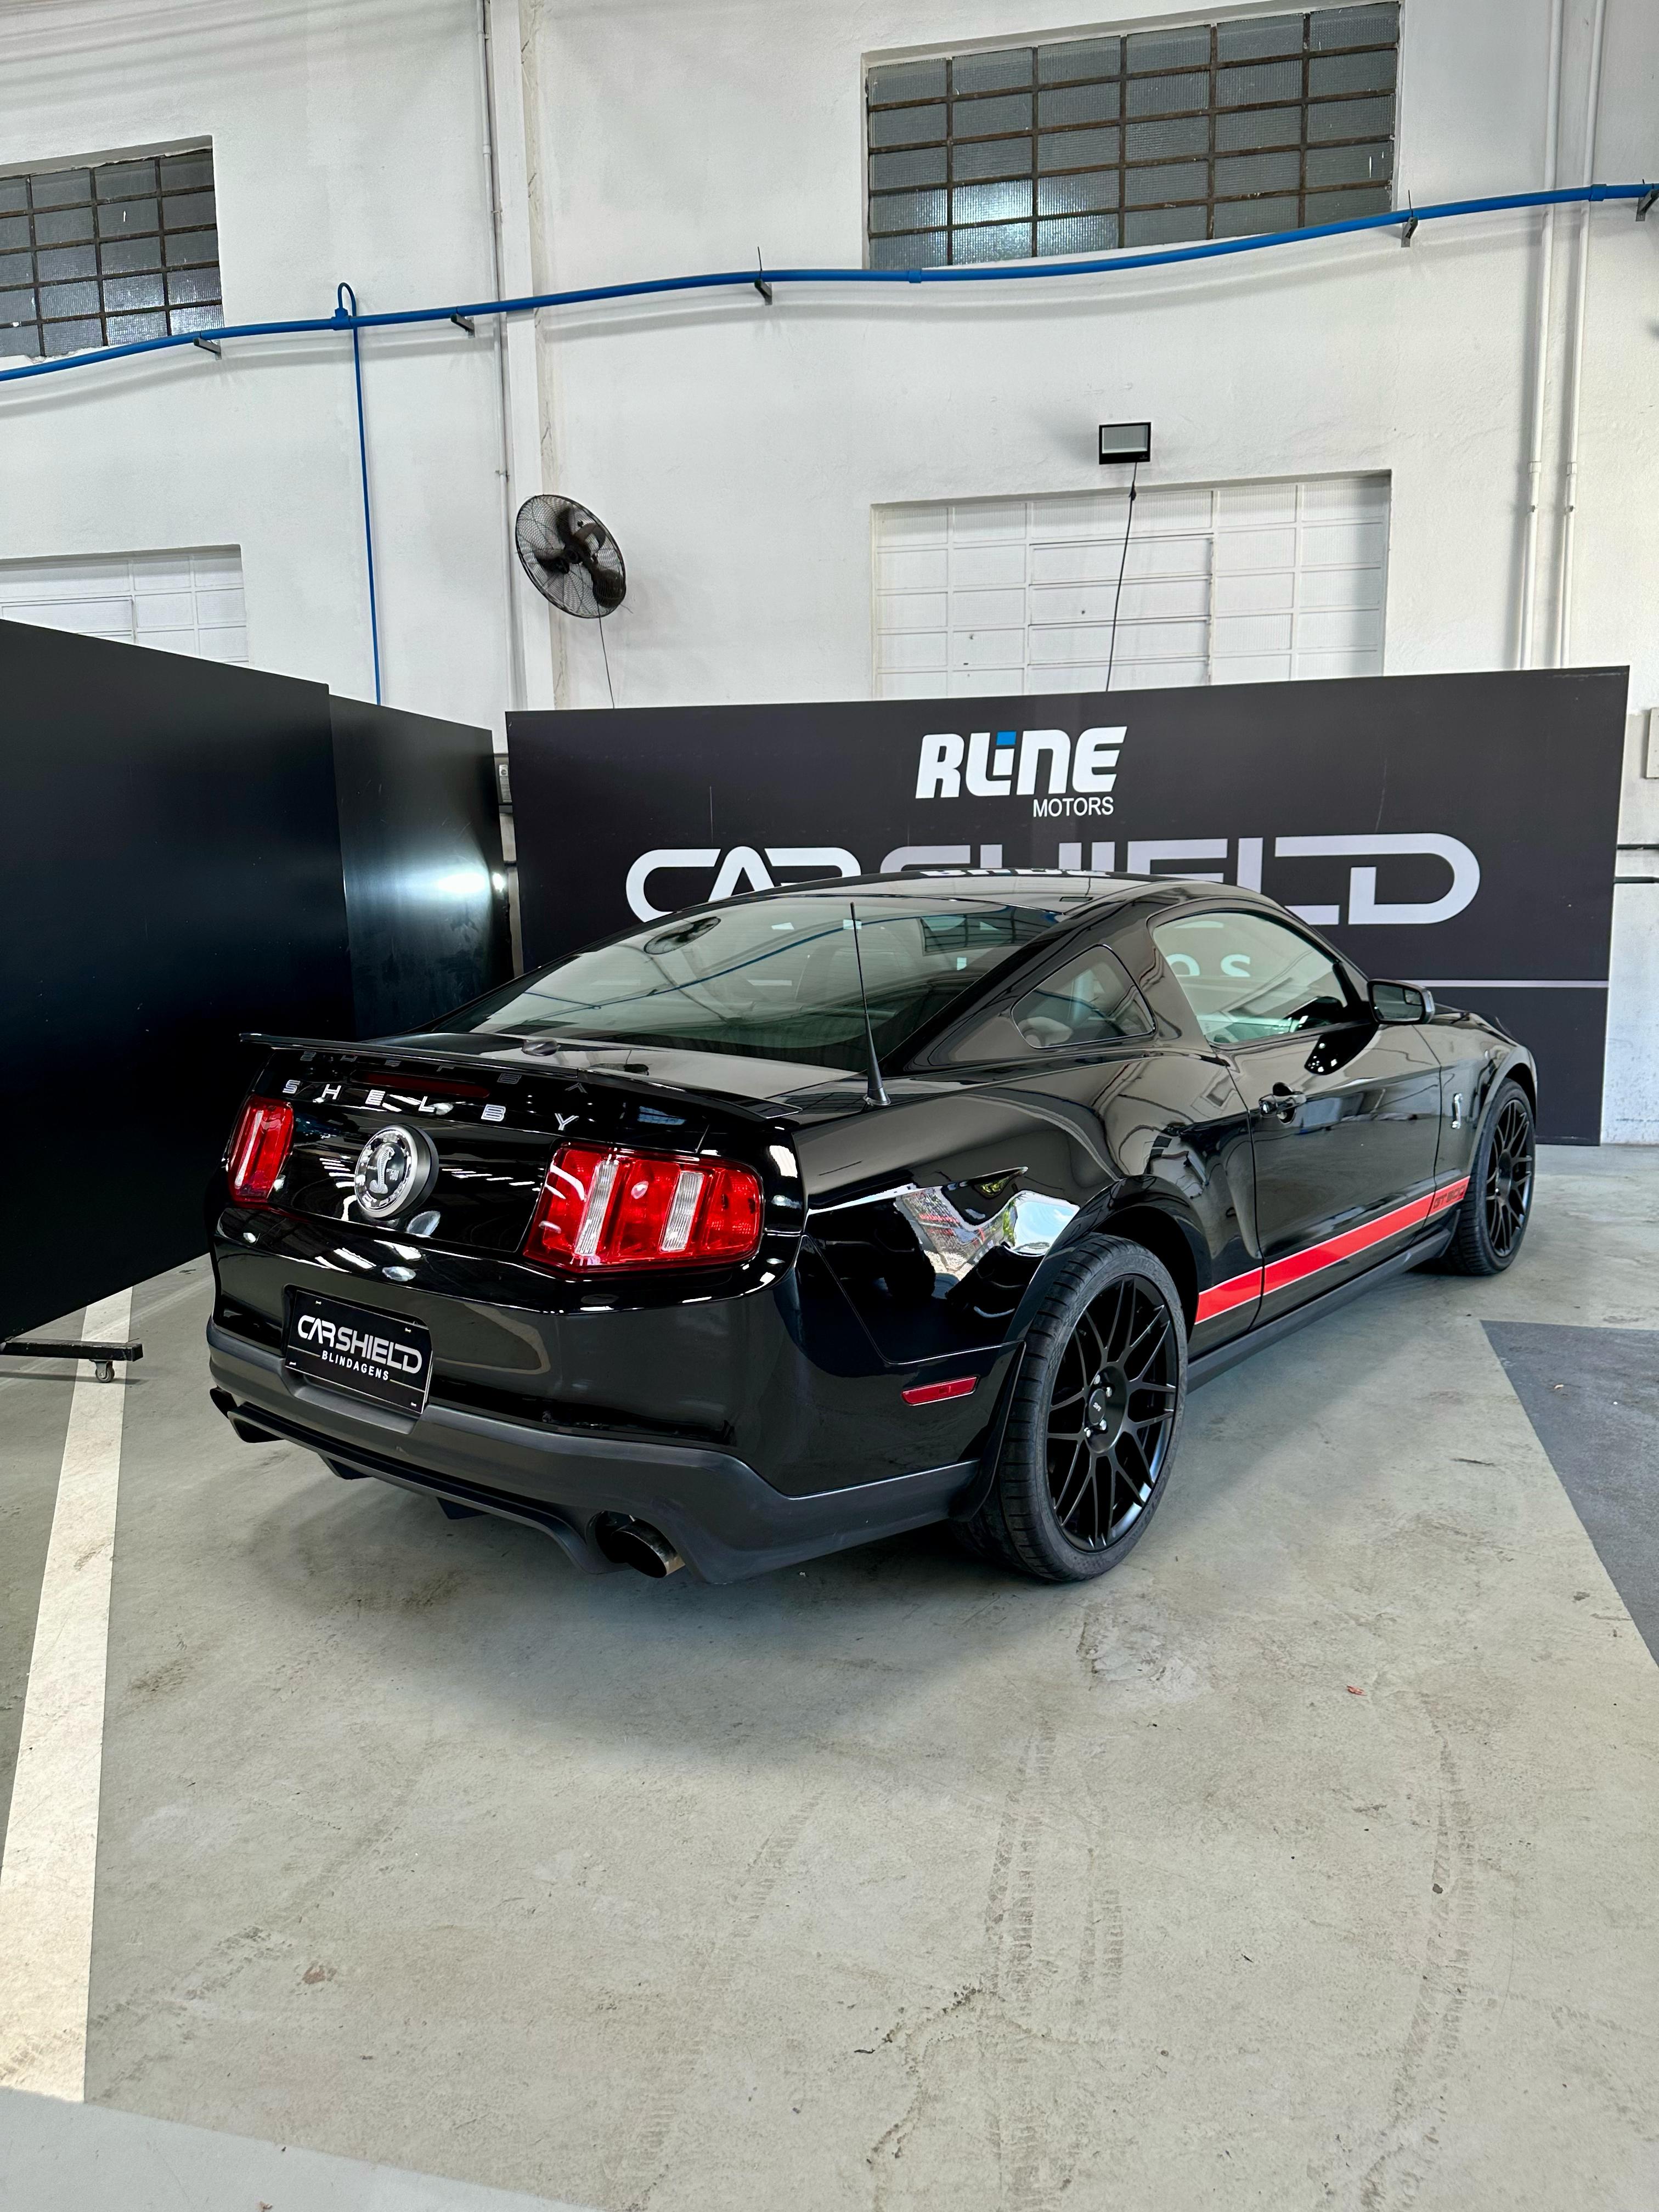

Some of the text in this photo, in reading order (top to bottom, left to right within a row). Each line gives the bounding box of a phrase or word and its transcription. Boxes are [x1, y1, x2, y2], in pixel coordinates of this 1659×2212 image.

[1034, 797, 1114, 817] MOTORS
[283, 1079, 579, 1131] SHELBY
[298, 1315, 422, 1374] CARSHIELD
[322, 1351, 388, 1380] BLINDAGENS
